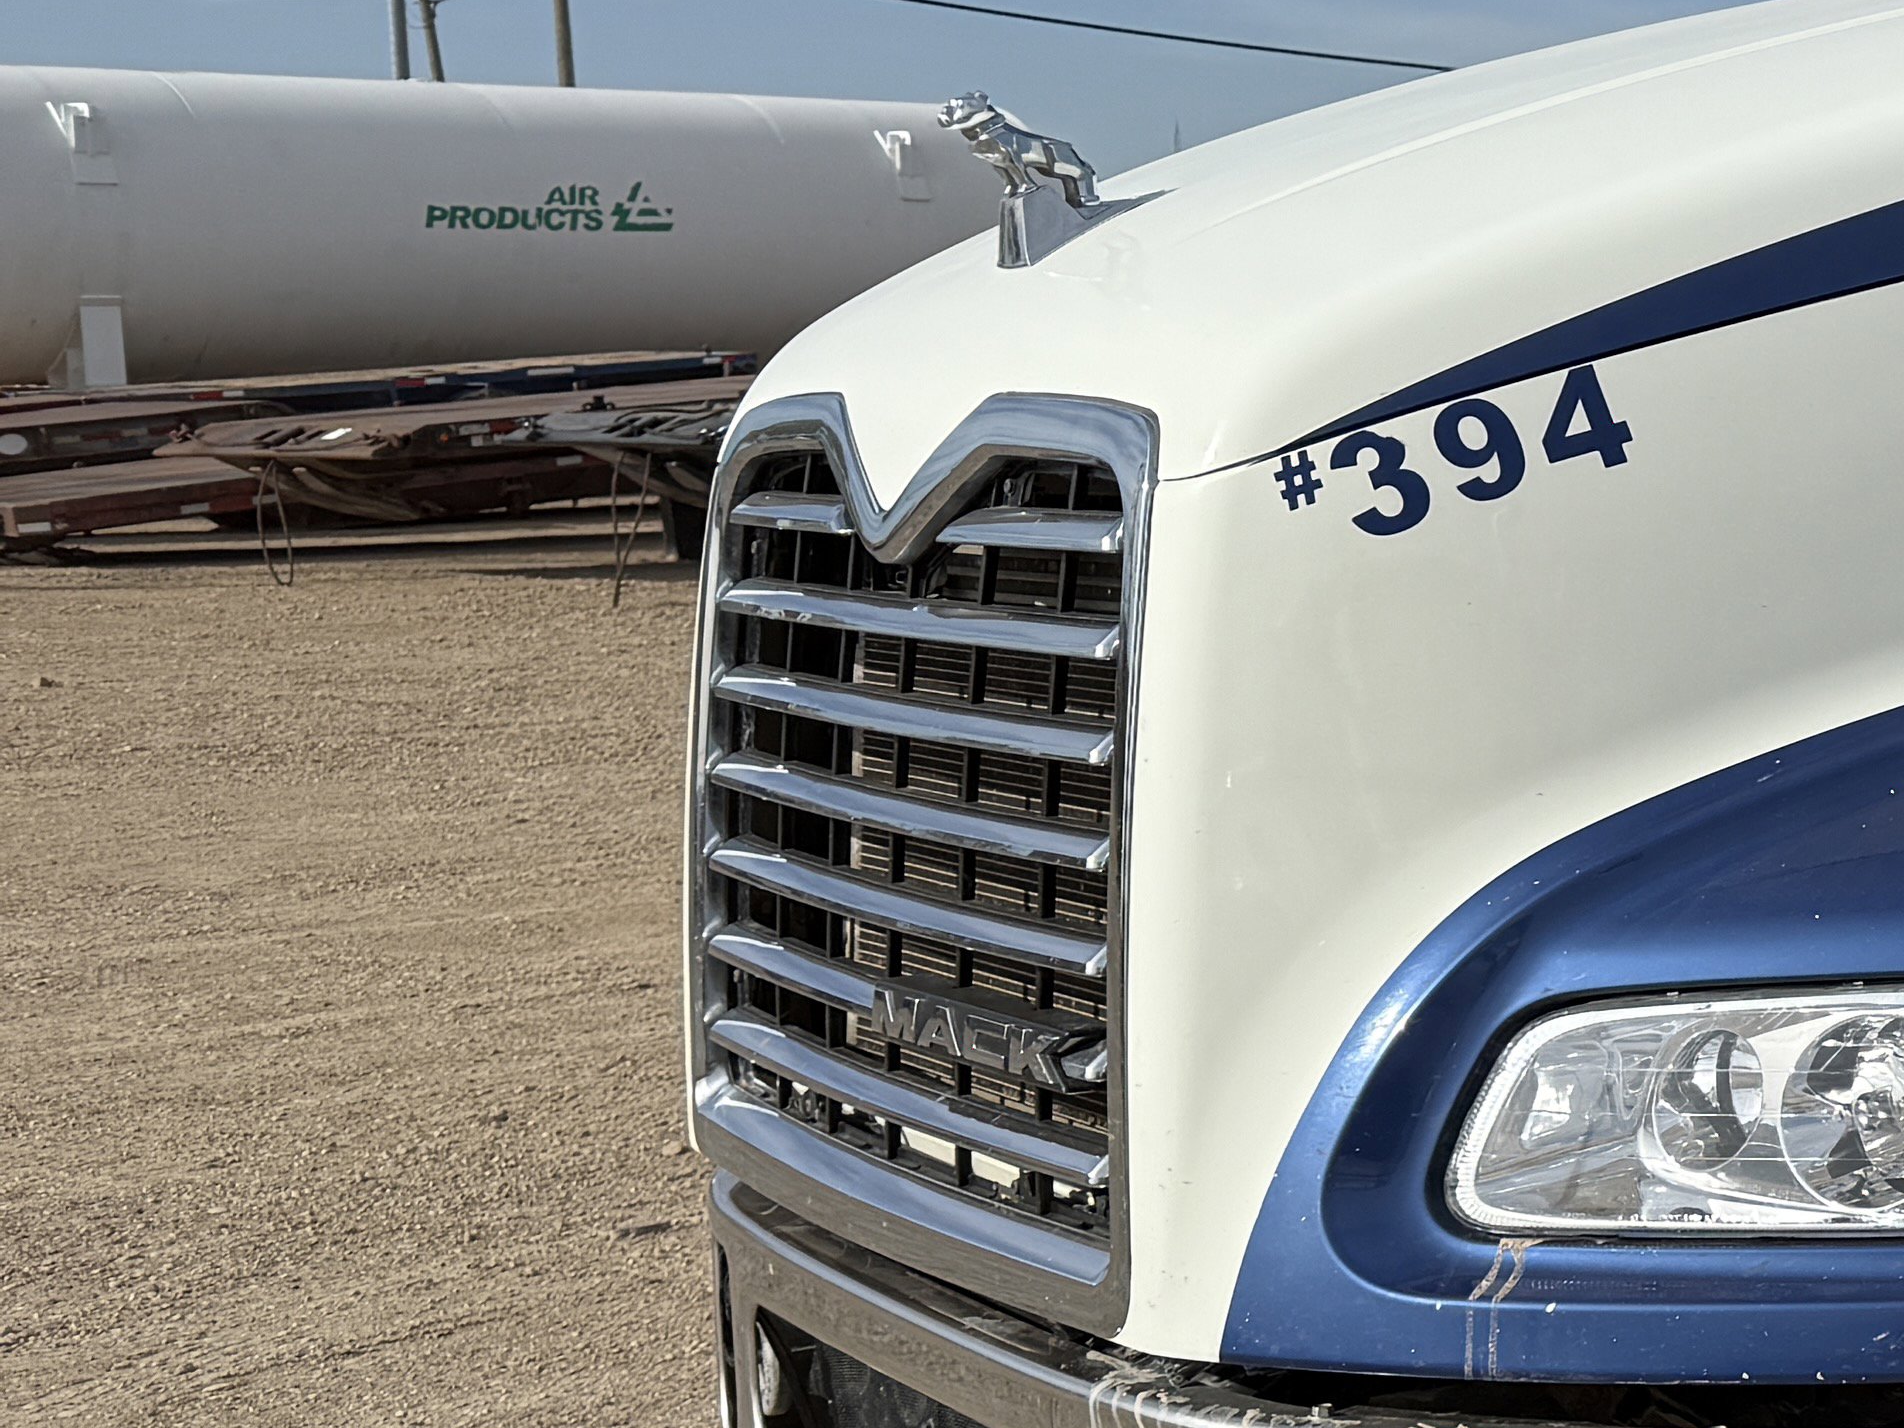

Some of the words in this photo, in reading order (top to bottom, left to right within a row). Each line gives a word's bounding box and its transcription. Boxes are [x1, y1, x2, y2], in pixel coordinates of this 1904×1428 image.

[425, 204, 604, 232] PRODUCTS
[545, 184, 600, 206] AIR
[1273, 363, 1634, 537] #394
[871, 988, 1068, 1092] MACK
